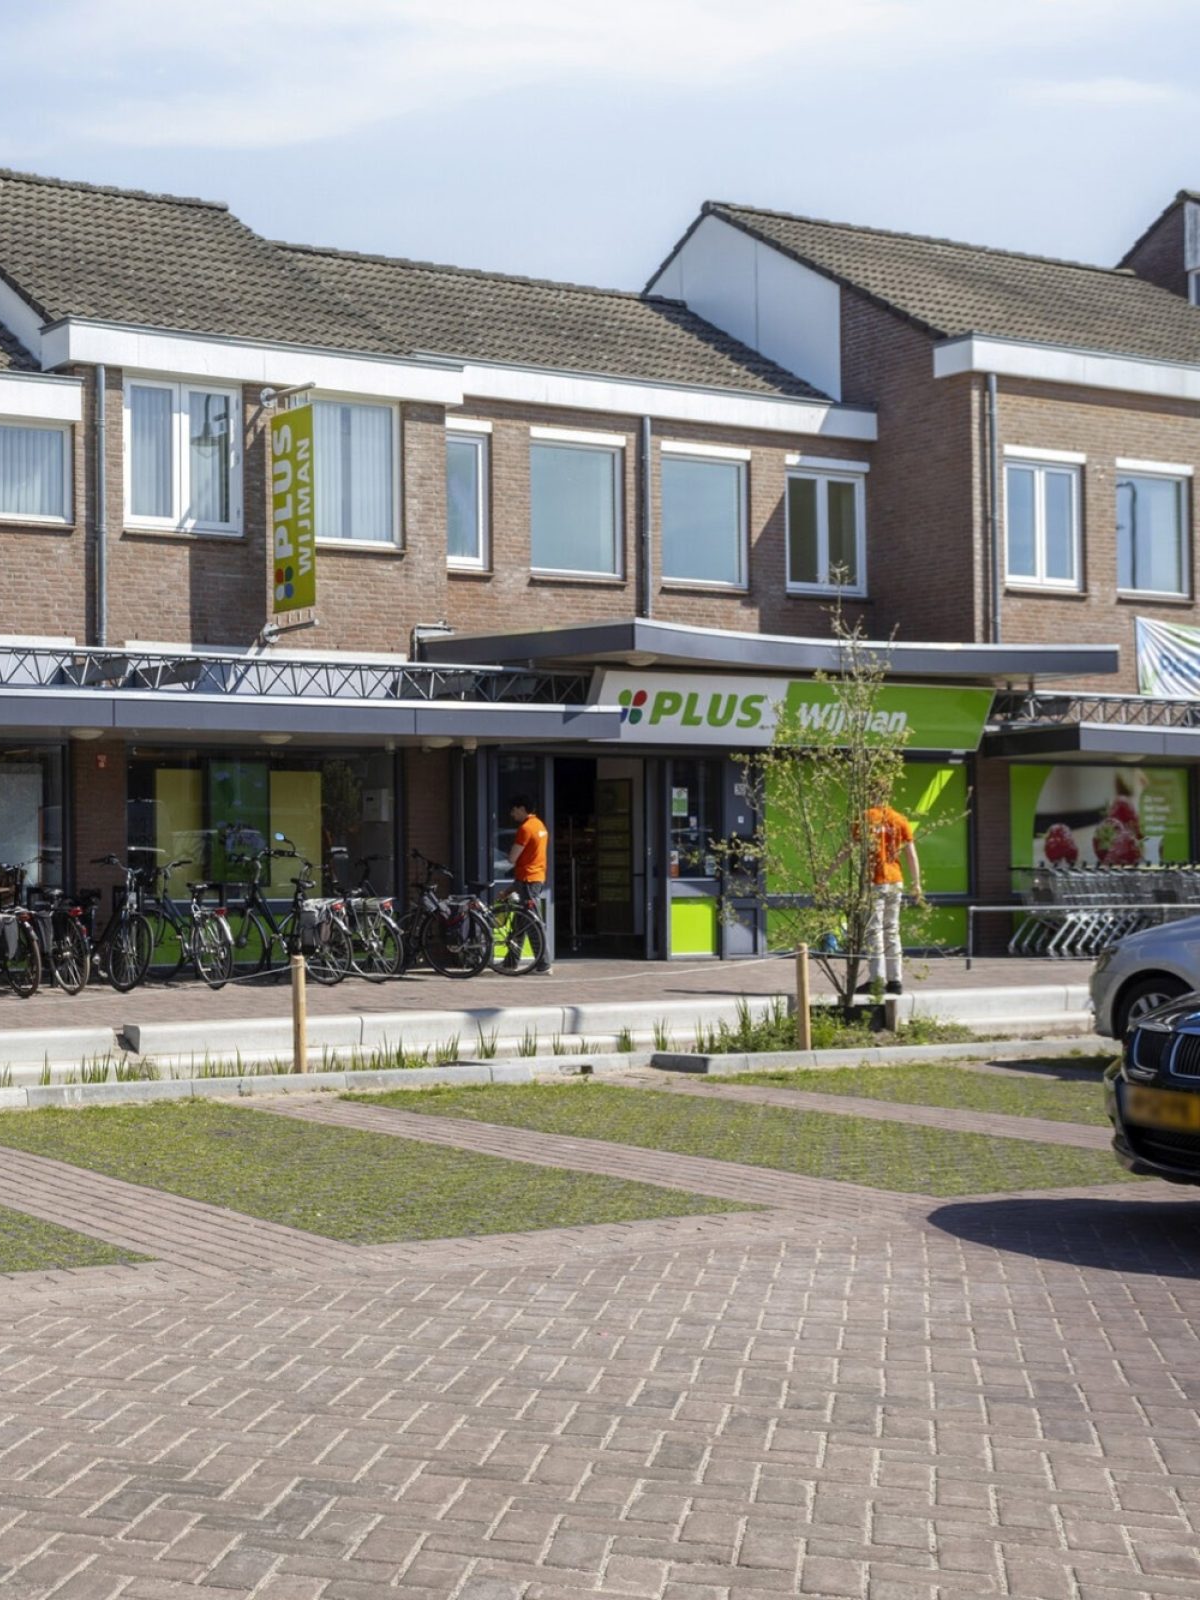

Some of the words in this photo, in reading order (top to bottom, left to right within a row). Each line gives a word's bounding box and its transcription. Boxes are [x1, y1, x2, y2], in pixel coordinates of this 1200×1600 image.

[273, 423, 294, 560] PLUS
[297, 438, 311, 576] WIJMAN
[648, 690, 767, 728] PLUS
